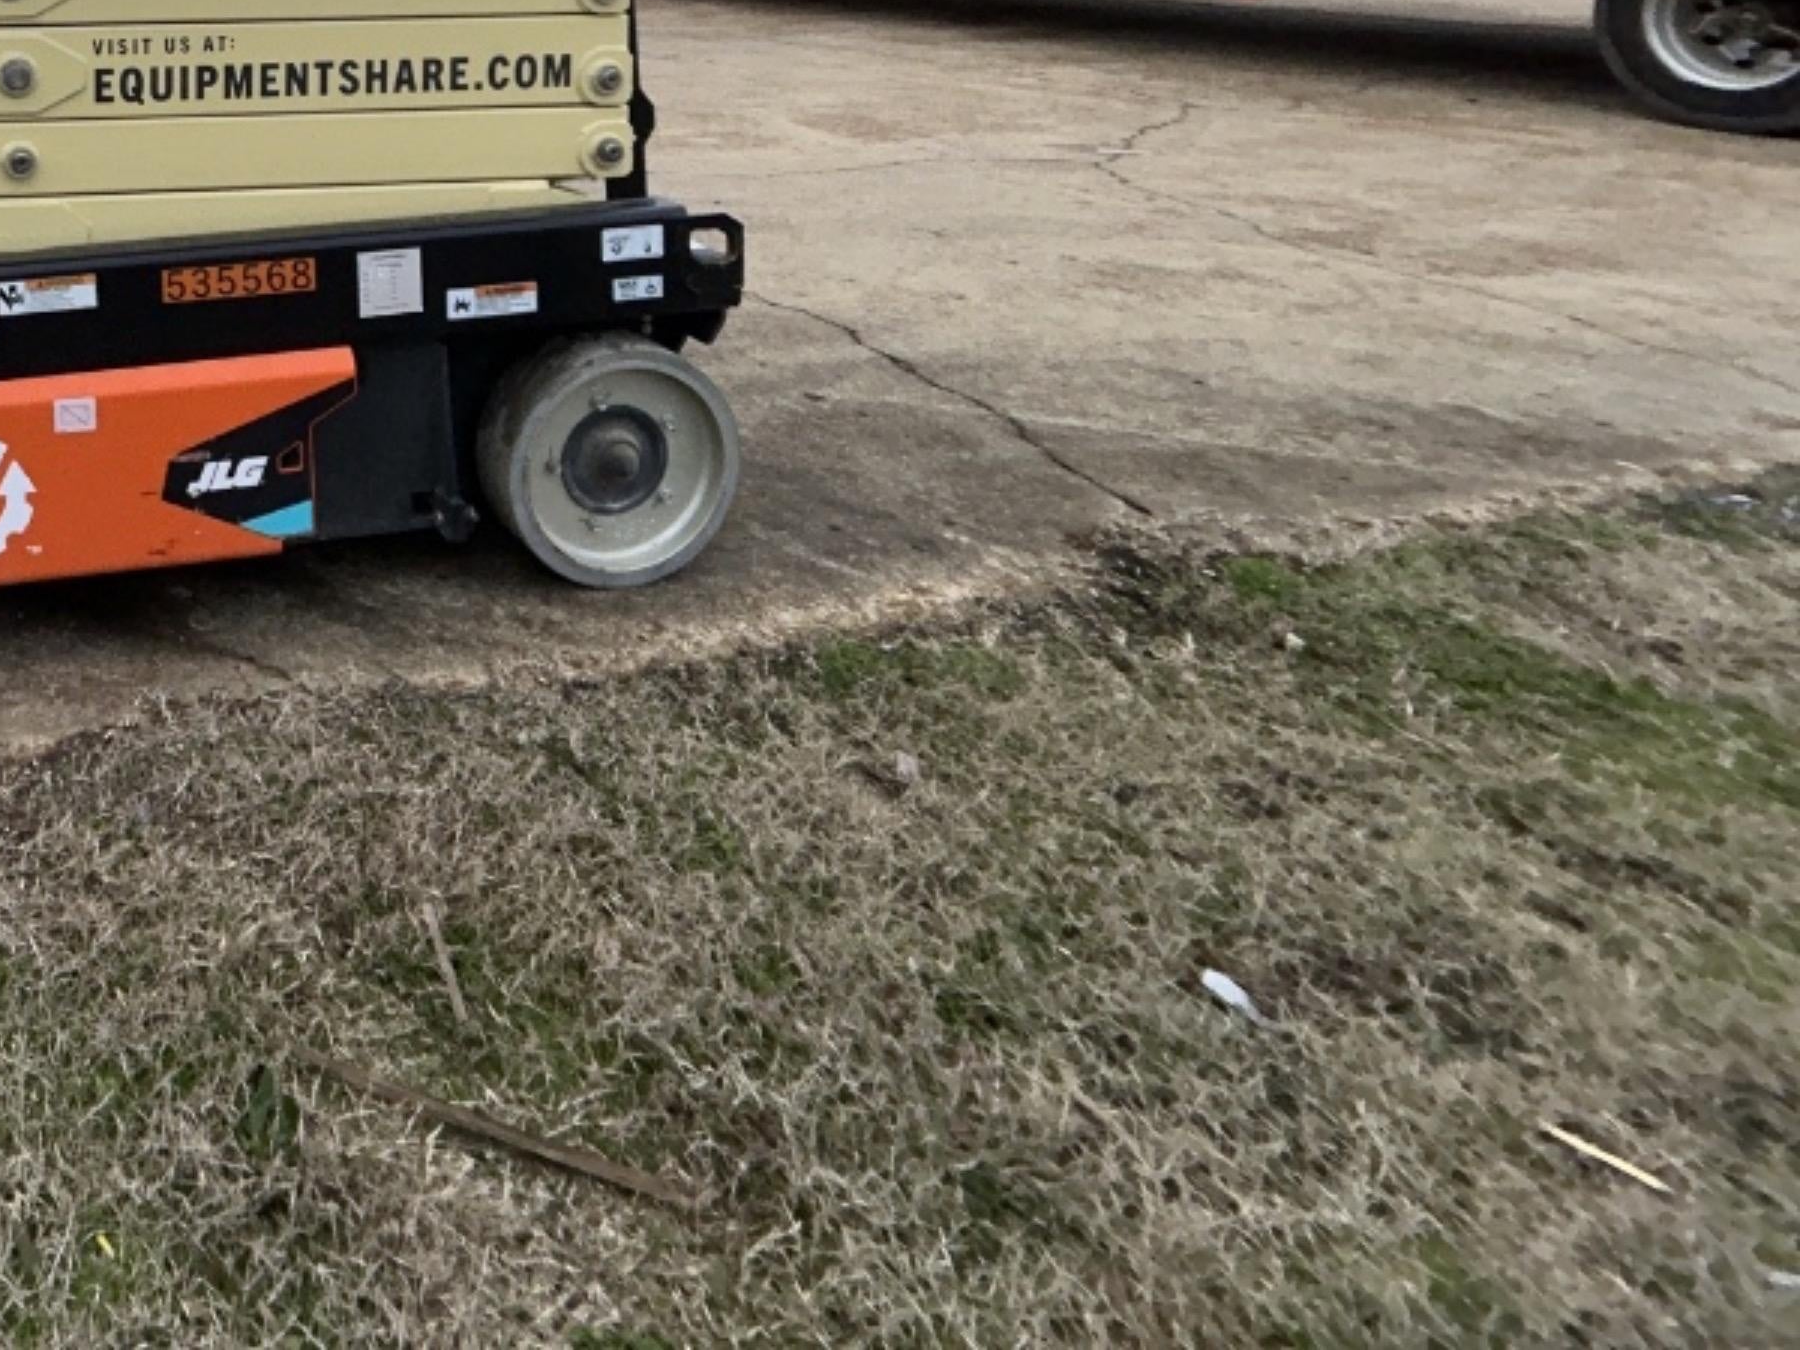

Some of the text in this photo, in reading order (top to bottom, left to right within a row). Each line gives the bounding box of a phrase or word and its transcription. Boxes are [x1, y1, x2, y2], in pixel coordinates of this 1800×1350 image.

[92, 35, 236, 56] VISIT US AT:
[93, 53, 572, 105] EQUIPMENTSHARE.COM
[167, 259, 312, 300] 535568
[186, 455, 269, 499] JLG
